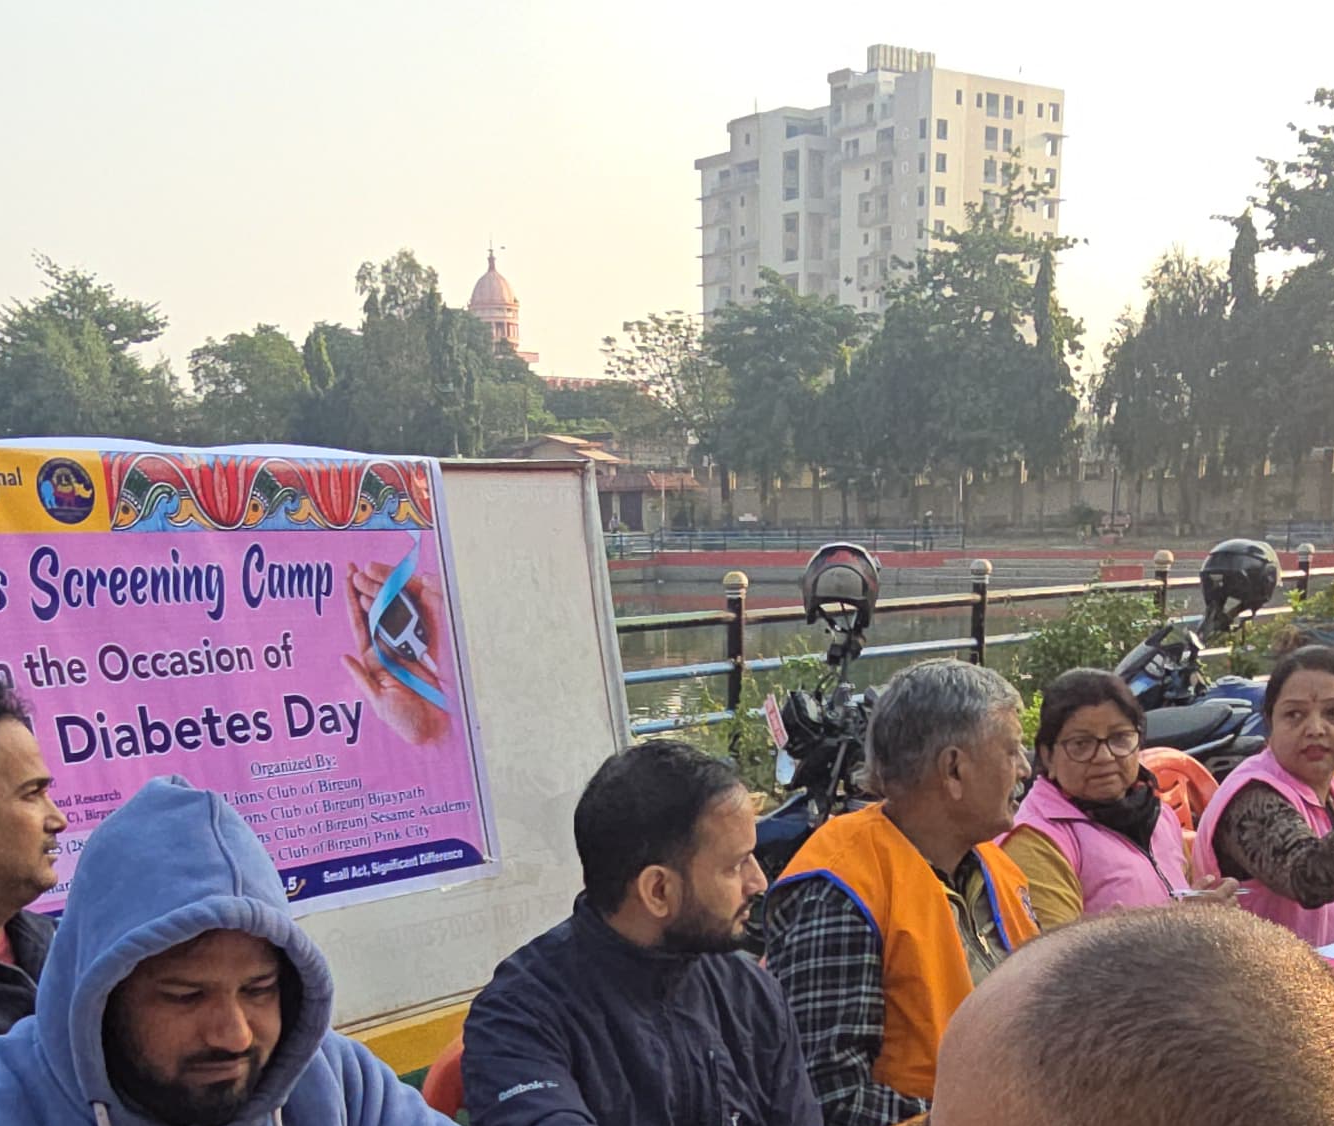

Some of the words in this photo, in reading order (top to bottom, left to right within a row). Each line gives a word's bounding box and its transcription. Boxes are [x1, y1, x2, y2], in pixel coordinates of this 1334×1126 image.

[29, 545, 227, 622] Screening
[240, 542, 334, 618] Camp
[22, 642, 88, 688] the
[95, 635, 255, 684] Occasion
[261, 631, 294, 671] of
[58, 703, 273, 765] Diabetes
[287, 694, 365, 745] Day
[251, 758, 312, 779] Organized
[316, 754, 338, 771] By:
[74, 789, 122, 806] Research
[223, 788, 264, 807] Lions
[267, 784, 297, 801] Club
[301, 781, 315, 795] of
[318, 777, 364, 794] Birgunj
[271, 806, 302, 821] Club
[306, 802, 320, 815] of
[322, 796, 367, 812] Birgunj
[368, 786, 426, 807] Bijaypath
[274, 826, 306, 841] Club
[310, 821, 324, 835] of
[326, 815, 369, 832] Birgunj
[371, 809, 416, 824] Sesame
[419, 801, 472, 818] Academy
[278, 844, 309, 860] Club
[313, 840, 327, 854] of
[327, 834, 372, 852] Birgunj
[375, 830, 401, 844] Pink
[405, 823, 430, 840] City
[323, 870, 349, 884] Small
[351, 866, 371, 880] Act,
[372, 856, 419, 876] Significant
[420, 848, 464, 866] Difference
